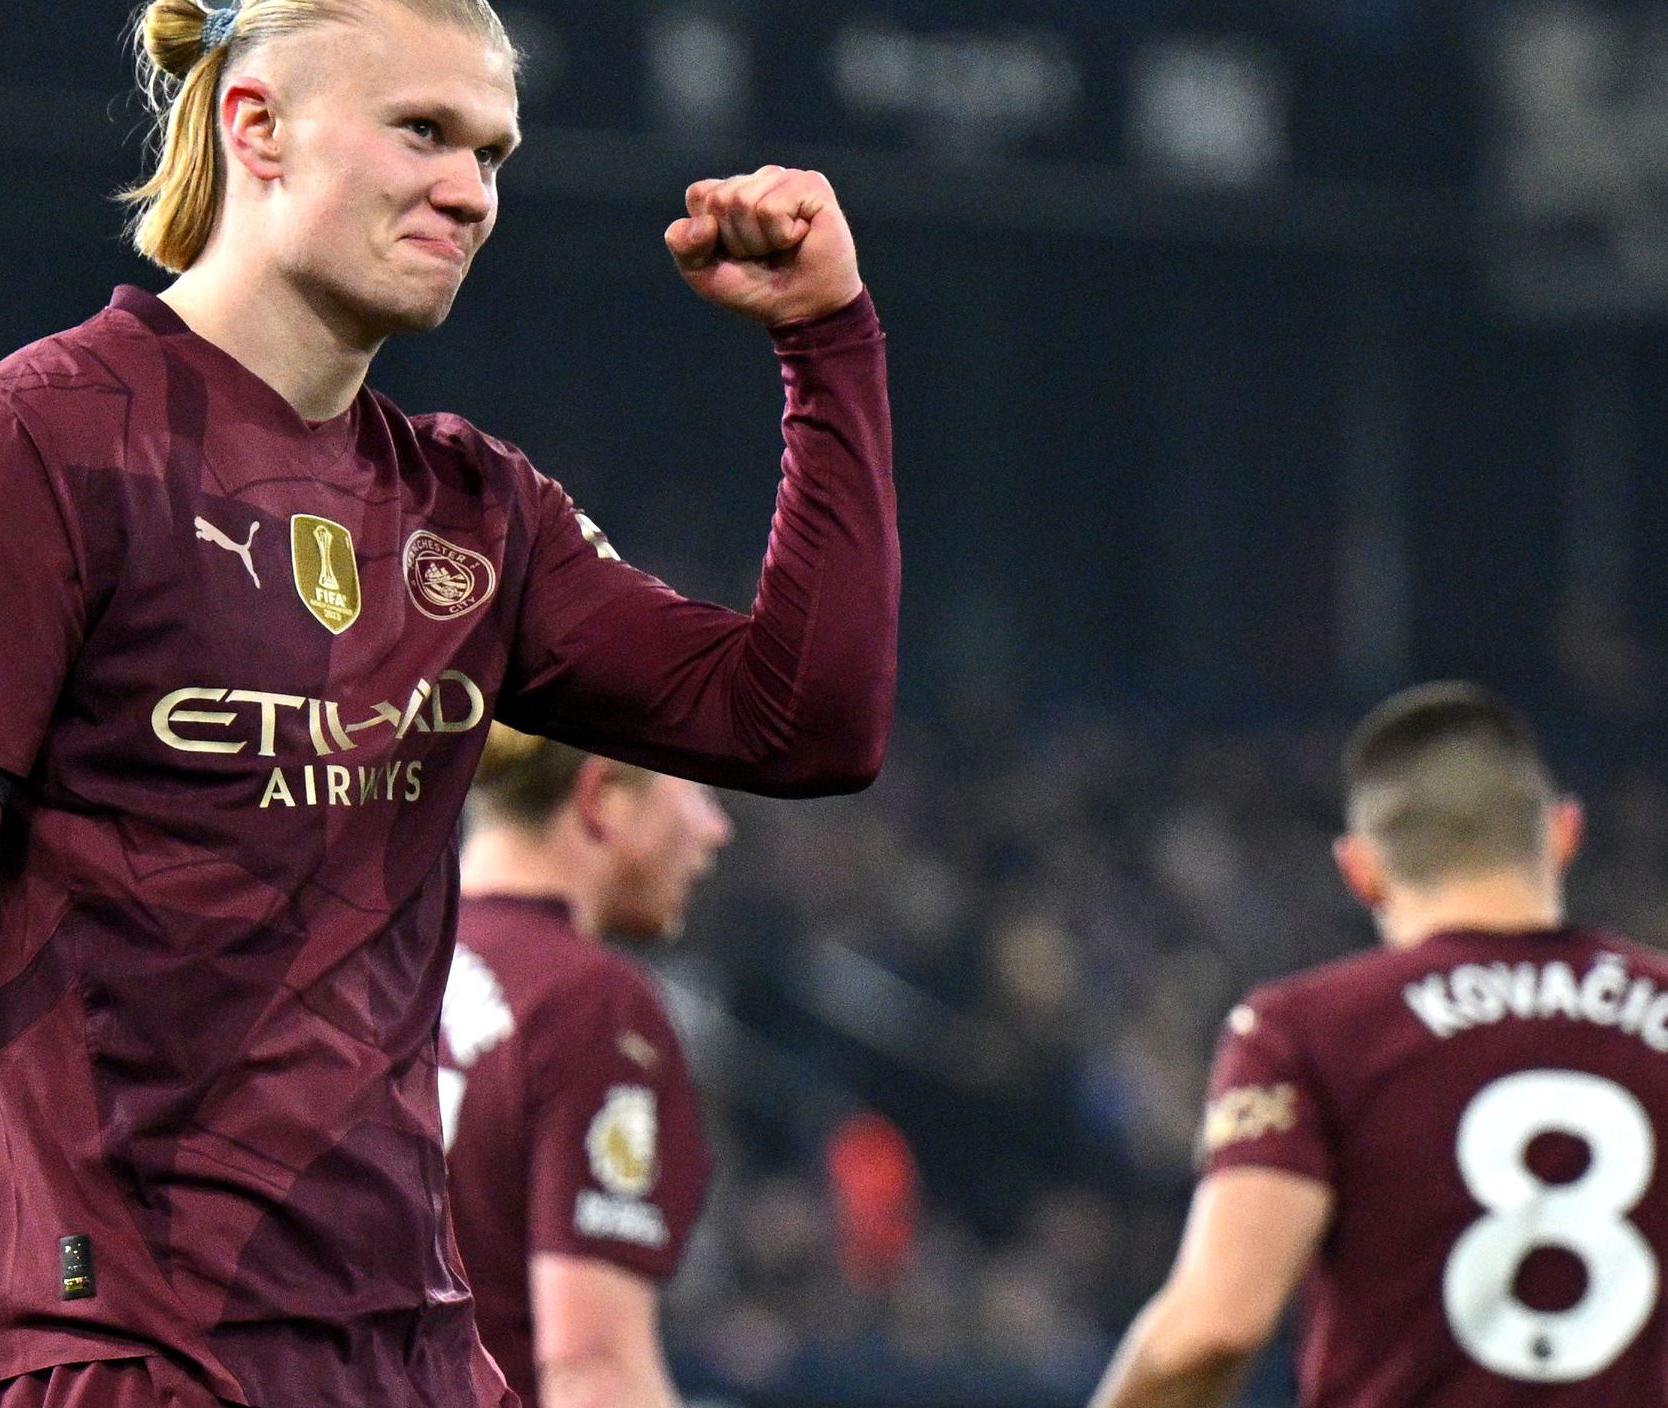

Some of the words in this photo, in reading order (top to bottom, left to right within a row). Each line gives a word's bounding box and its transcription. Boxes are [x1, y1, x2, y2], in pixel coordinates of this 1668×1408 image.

[315, 586, 346, 609] FIFA
[448, 596, 476, 613] CITY
[1442, 1067, 1660, 1383] 8
